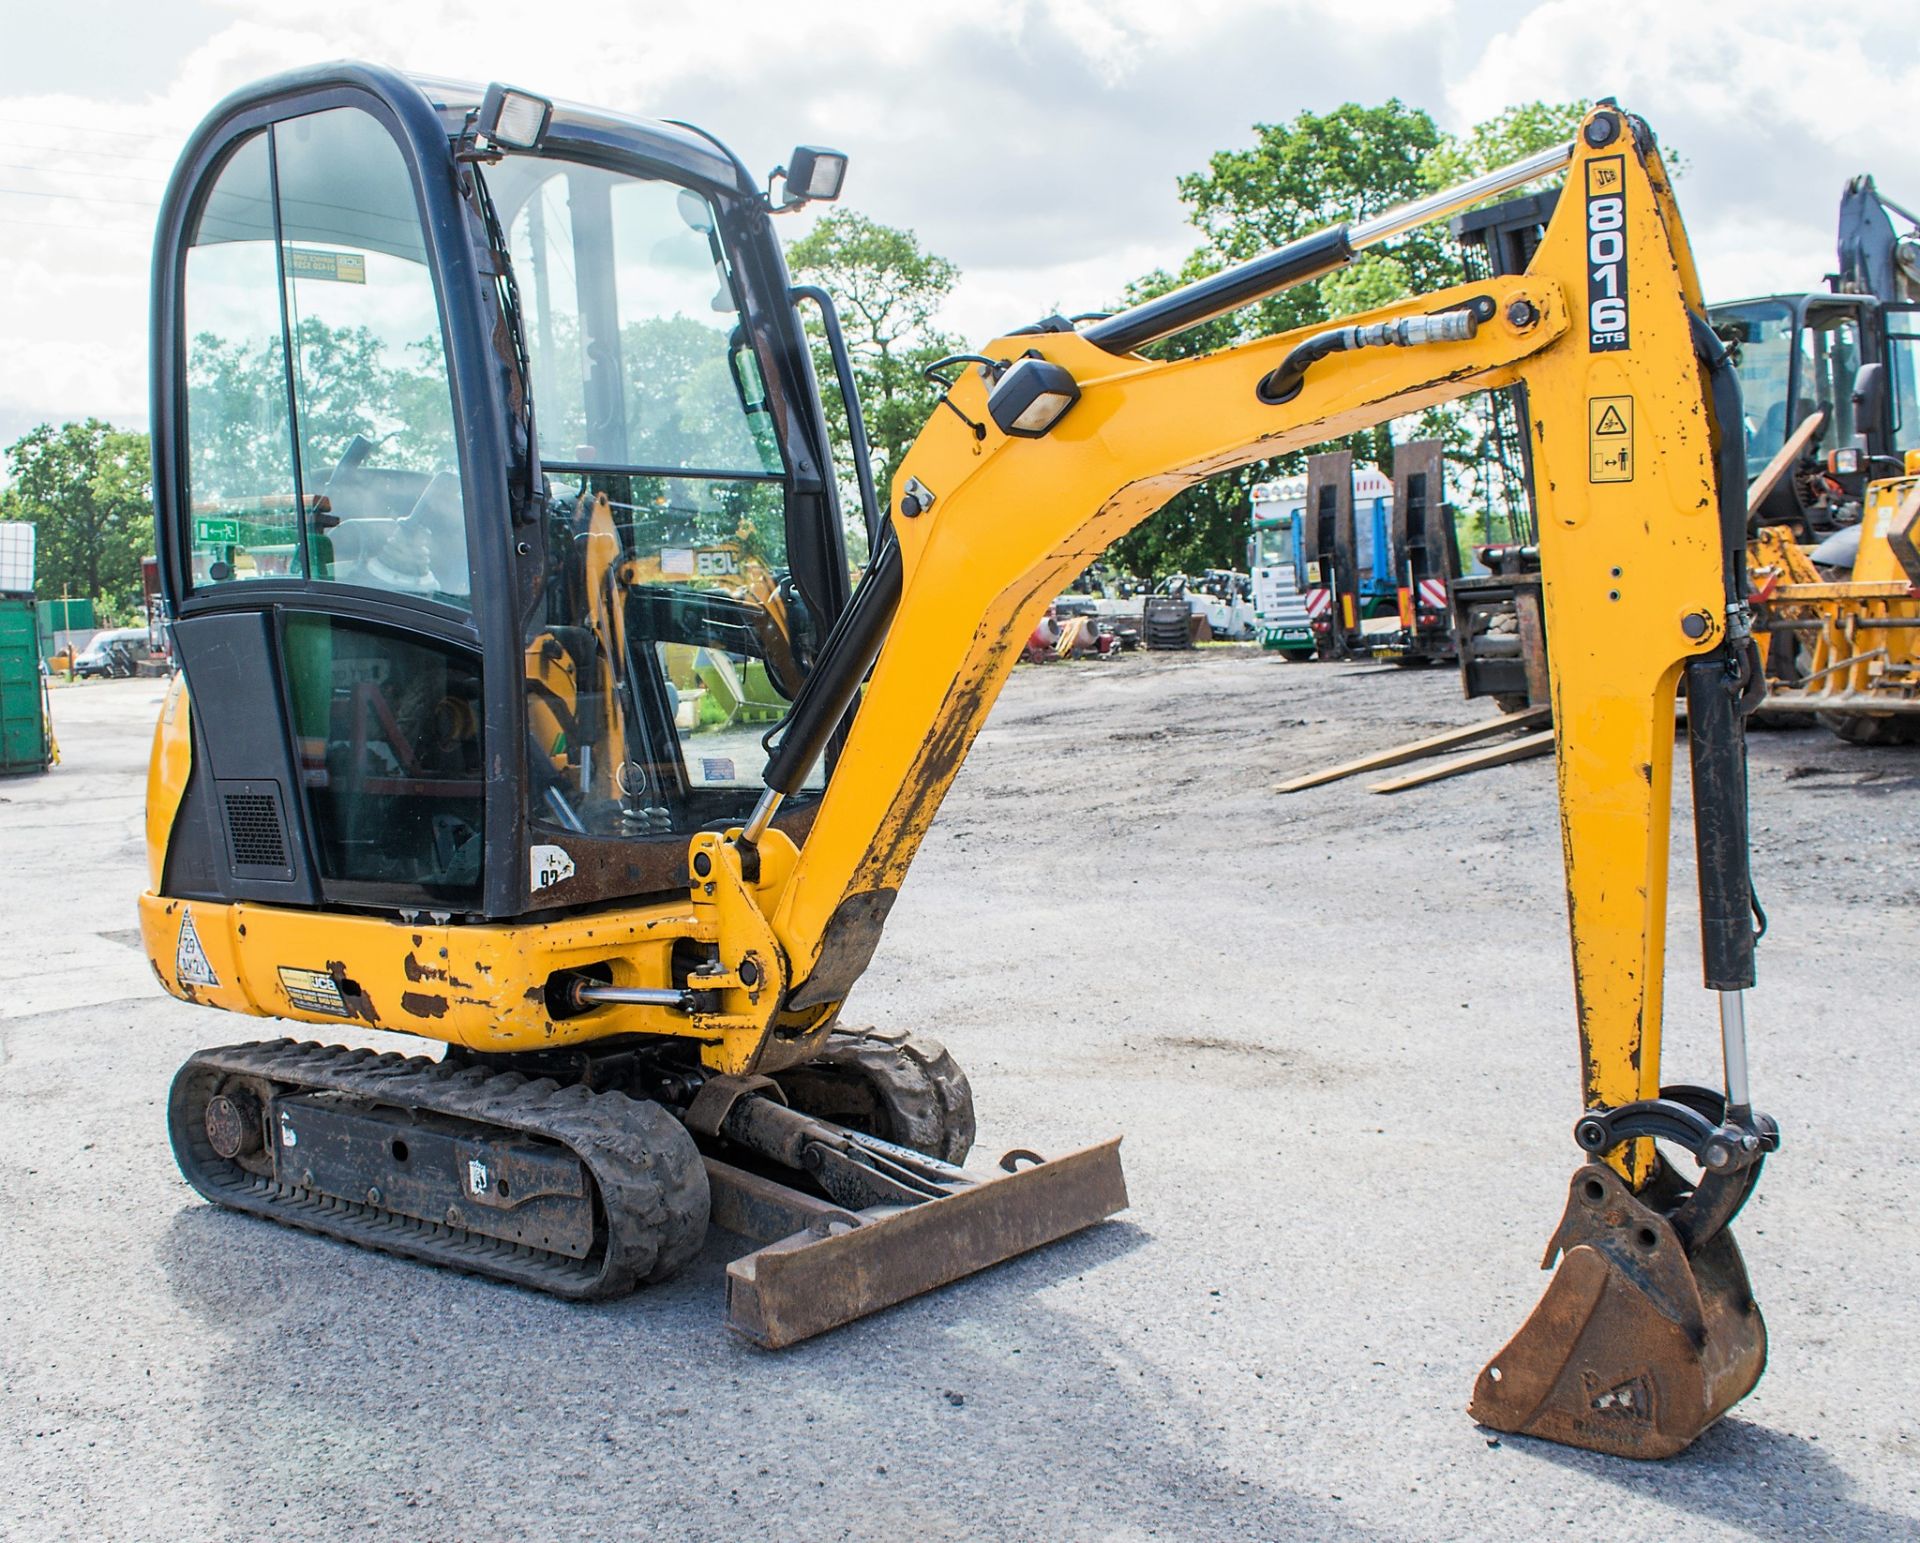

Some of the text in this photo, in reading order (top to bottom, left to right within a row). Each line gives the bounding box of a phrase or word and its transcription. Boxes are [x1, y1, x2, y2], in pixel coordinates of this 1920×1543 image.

[1597, 169, 1617, 186] JCB
[1588, 197, 1627, 334] 8016
[1591, 331, 1626, 345] CTS
[311, 975, 338, 991] JCB
